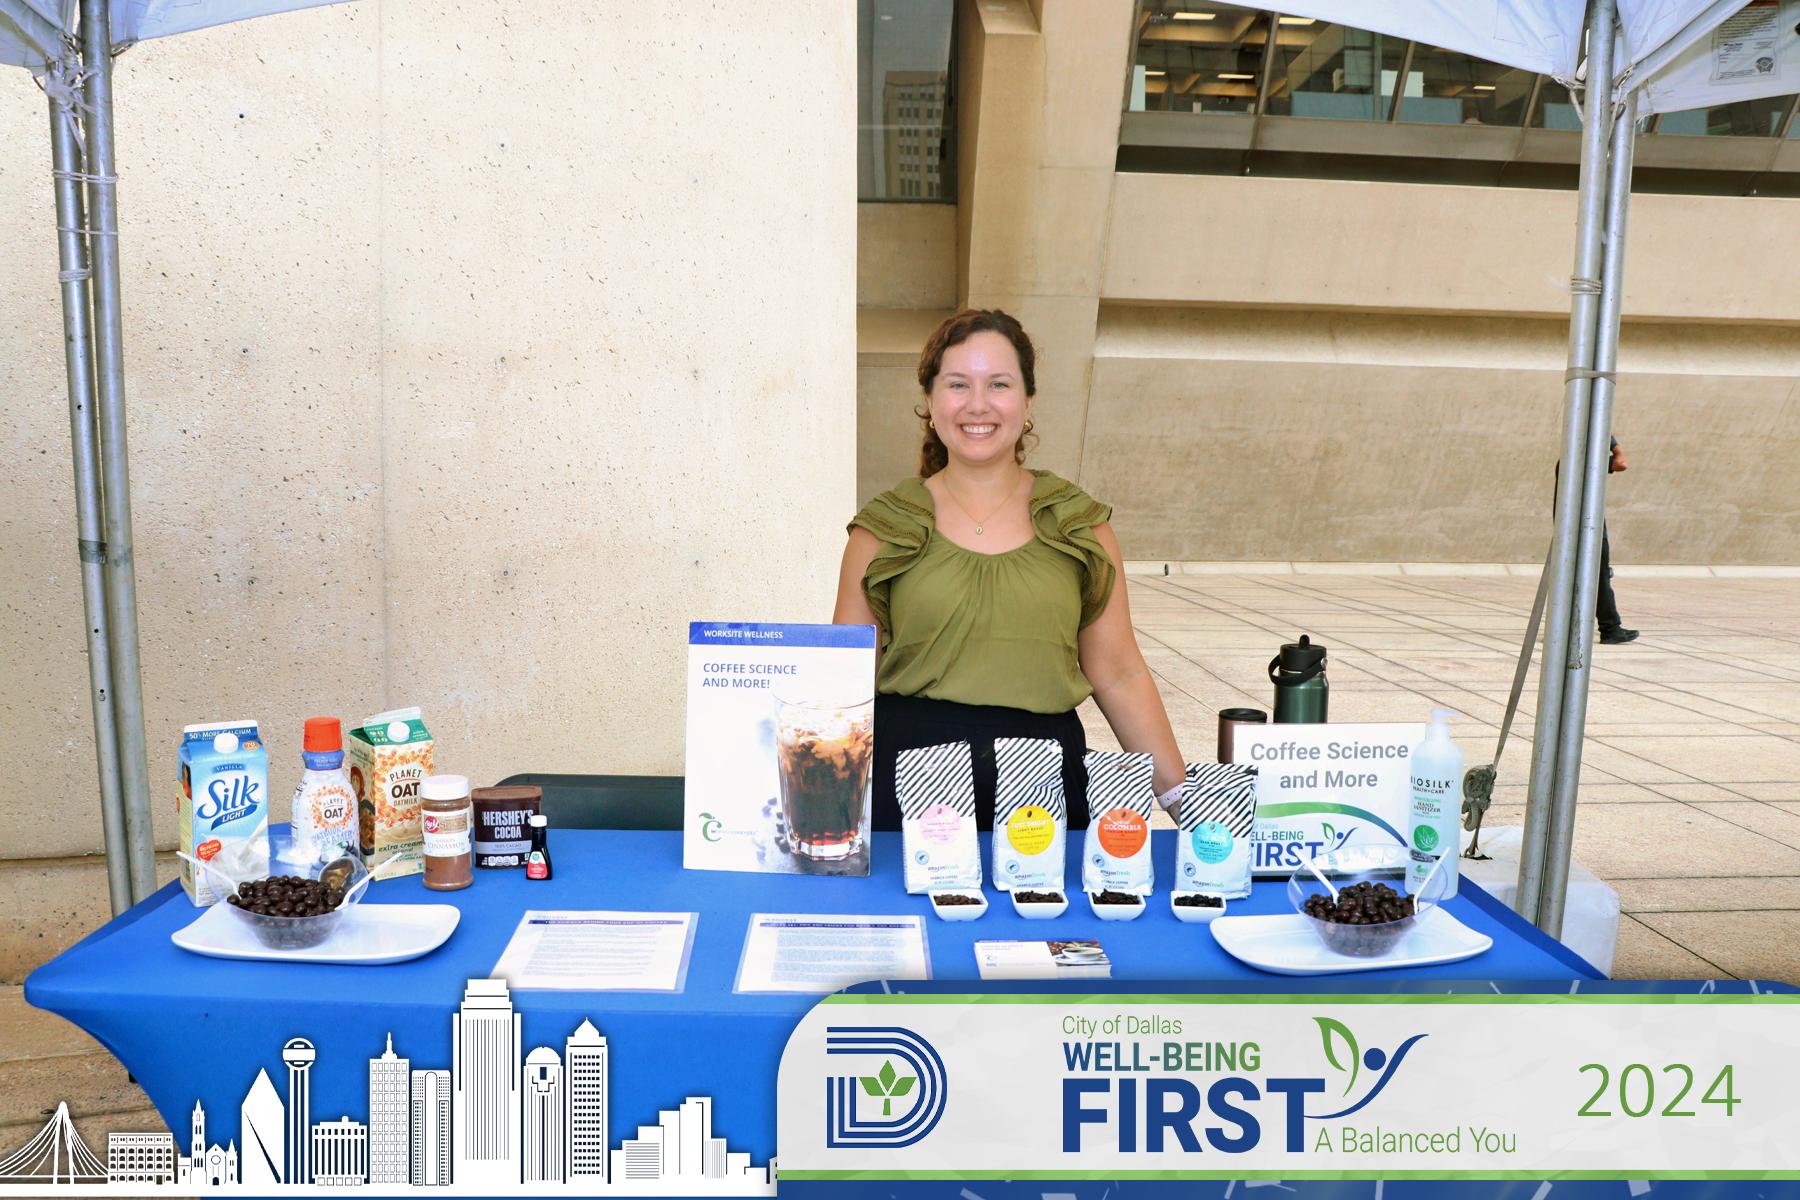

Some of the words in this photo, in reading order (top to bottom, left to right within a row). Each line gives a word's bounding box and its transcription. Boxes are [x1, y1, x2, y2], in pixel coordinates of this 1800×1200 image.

[704, 629, 743, 638] WORKSITE
[744, 630, 783, 639] WELLNESS
[703, 663, 746, 674] COFFEE
[749, 664, 797, 675] SCIENCE
[702, 678, 729, 688] AND
[732, 679, 770, 689] MORE!
[1250, 741, 1321, 761] Coffee
[1327, 741, 1409, 760] Science
[217, 764, 243, 772] VANILLA
[390, 769, 422, 782] PLANET
[1280, 771, 1318, 788] and
[1324, 770, 1378, 788] More
[391, 782, 421, 798] OAT
[197, 775, 260, 819] Silk
[393, 797, 418, 807] OATMILK
[222, 809, 247, 823] LIGHT
[324, 807, 344, 819] OAT
[482, 809, 534, 826] HERSHEY'S
[494, 826, 522, 839] COCOA
[1251, 830, 1304, 842] ELL-BEING
[378, 843, 399, 853] extra
[400, 840, 425, 849] cream
[427, 842, 465, 850] CINNAMON
[1251, 842, 1324, 868] IRST
